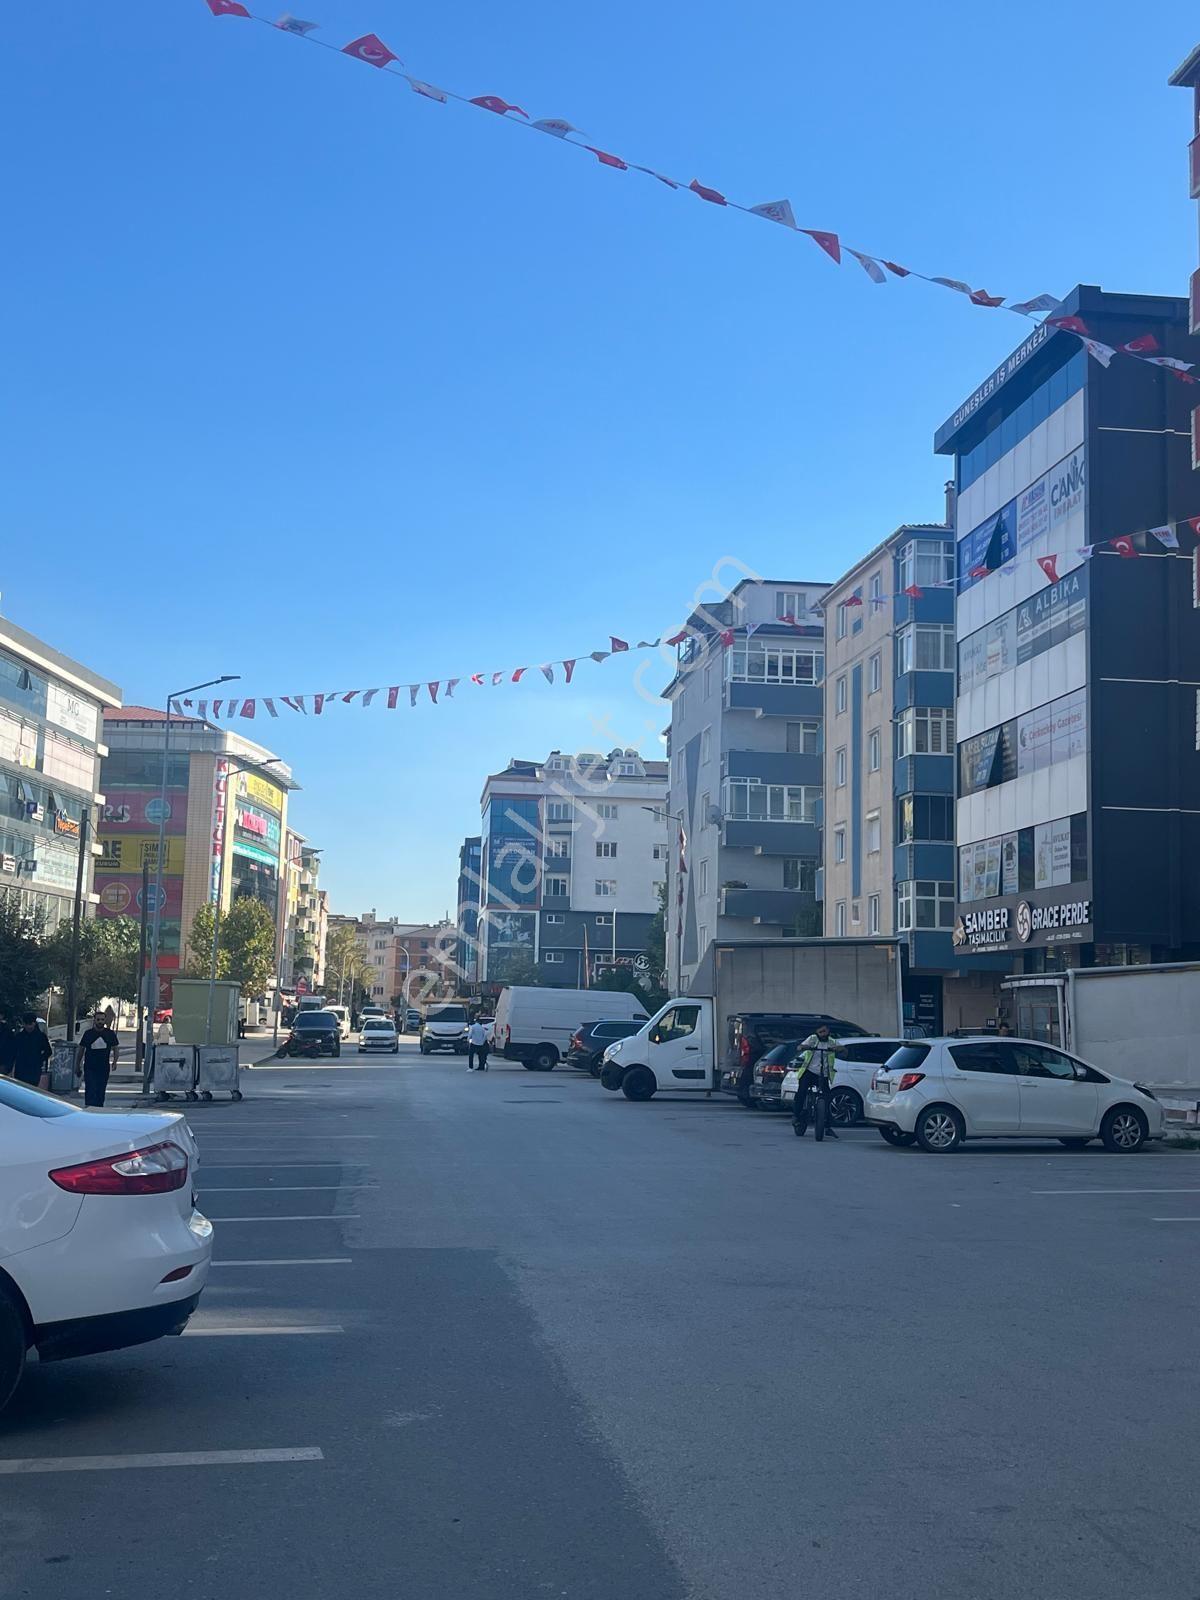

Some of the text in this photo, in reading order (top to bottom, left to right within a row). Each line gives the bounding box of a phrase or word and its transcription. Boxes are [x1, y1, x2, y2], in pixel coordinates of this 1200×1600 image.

[1035, 576, 1080, 614] ALBİKA
[965, 908, 1009, 934] SAMBER
[1031, 901, 1090, 931] GRACE PERDE
[968, 930, 1007, 947] TAŞIMACILIK
